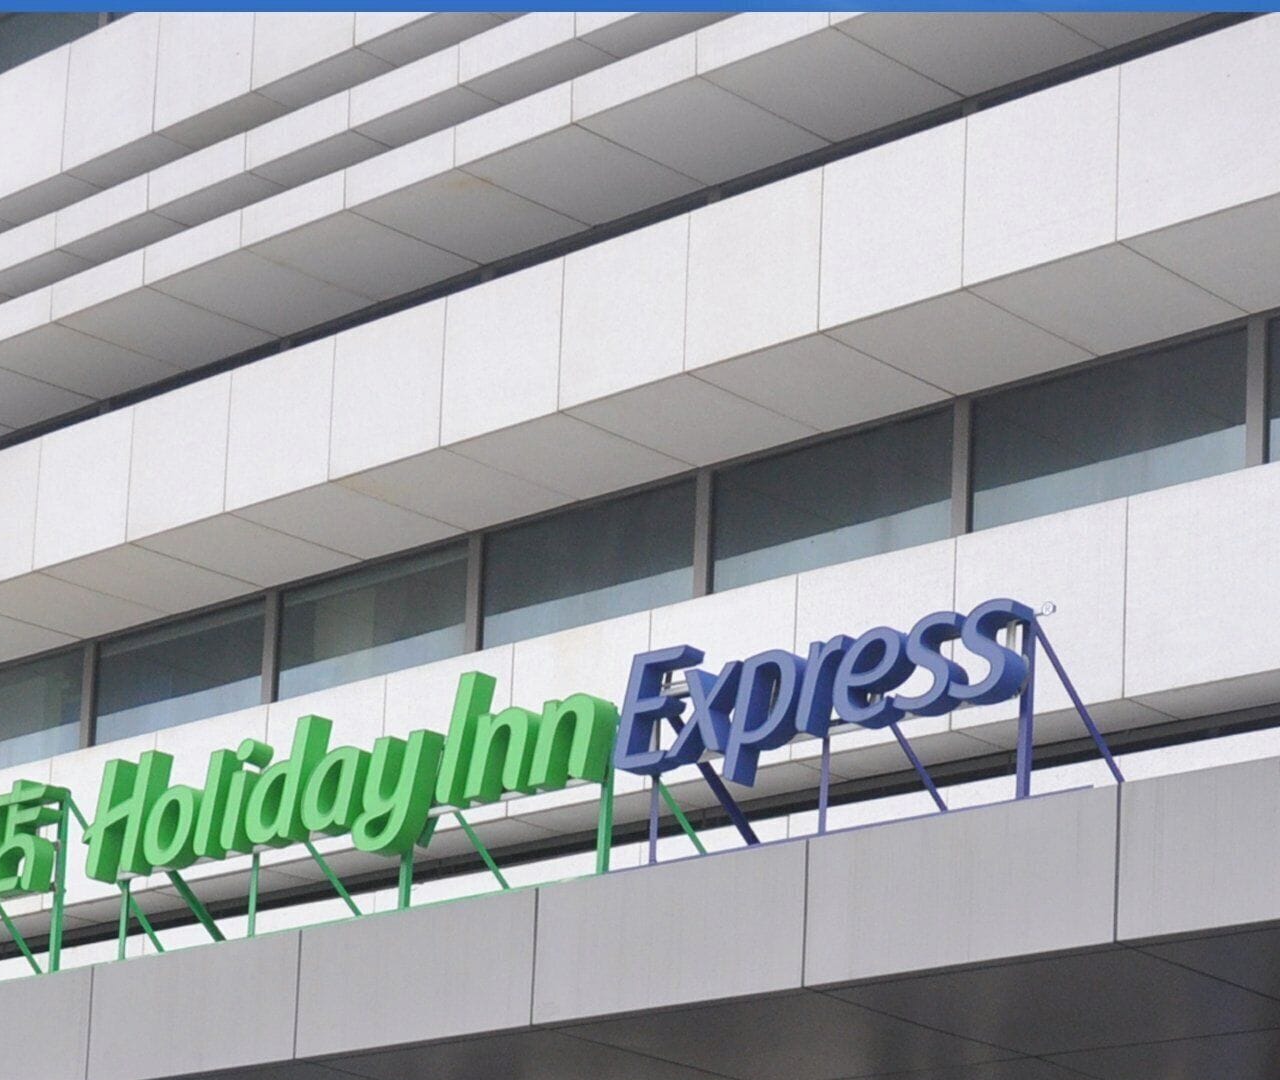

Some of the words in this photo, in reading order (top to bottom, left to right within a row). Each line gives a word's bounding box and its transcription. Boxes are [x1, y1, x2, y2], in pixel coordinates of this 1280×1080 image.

[82, 714, 446, 884] Holiday
[436, 671, 618, 808] Inn
[614, 597, 1035, 787] Express
